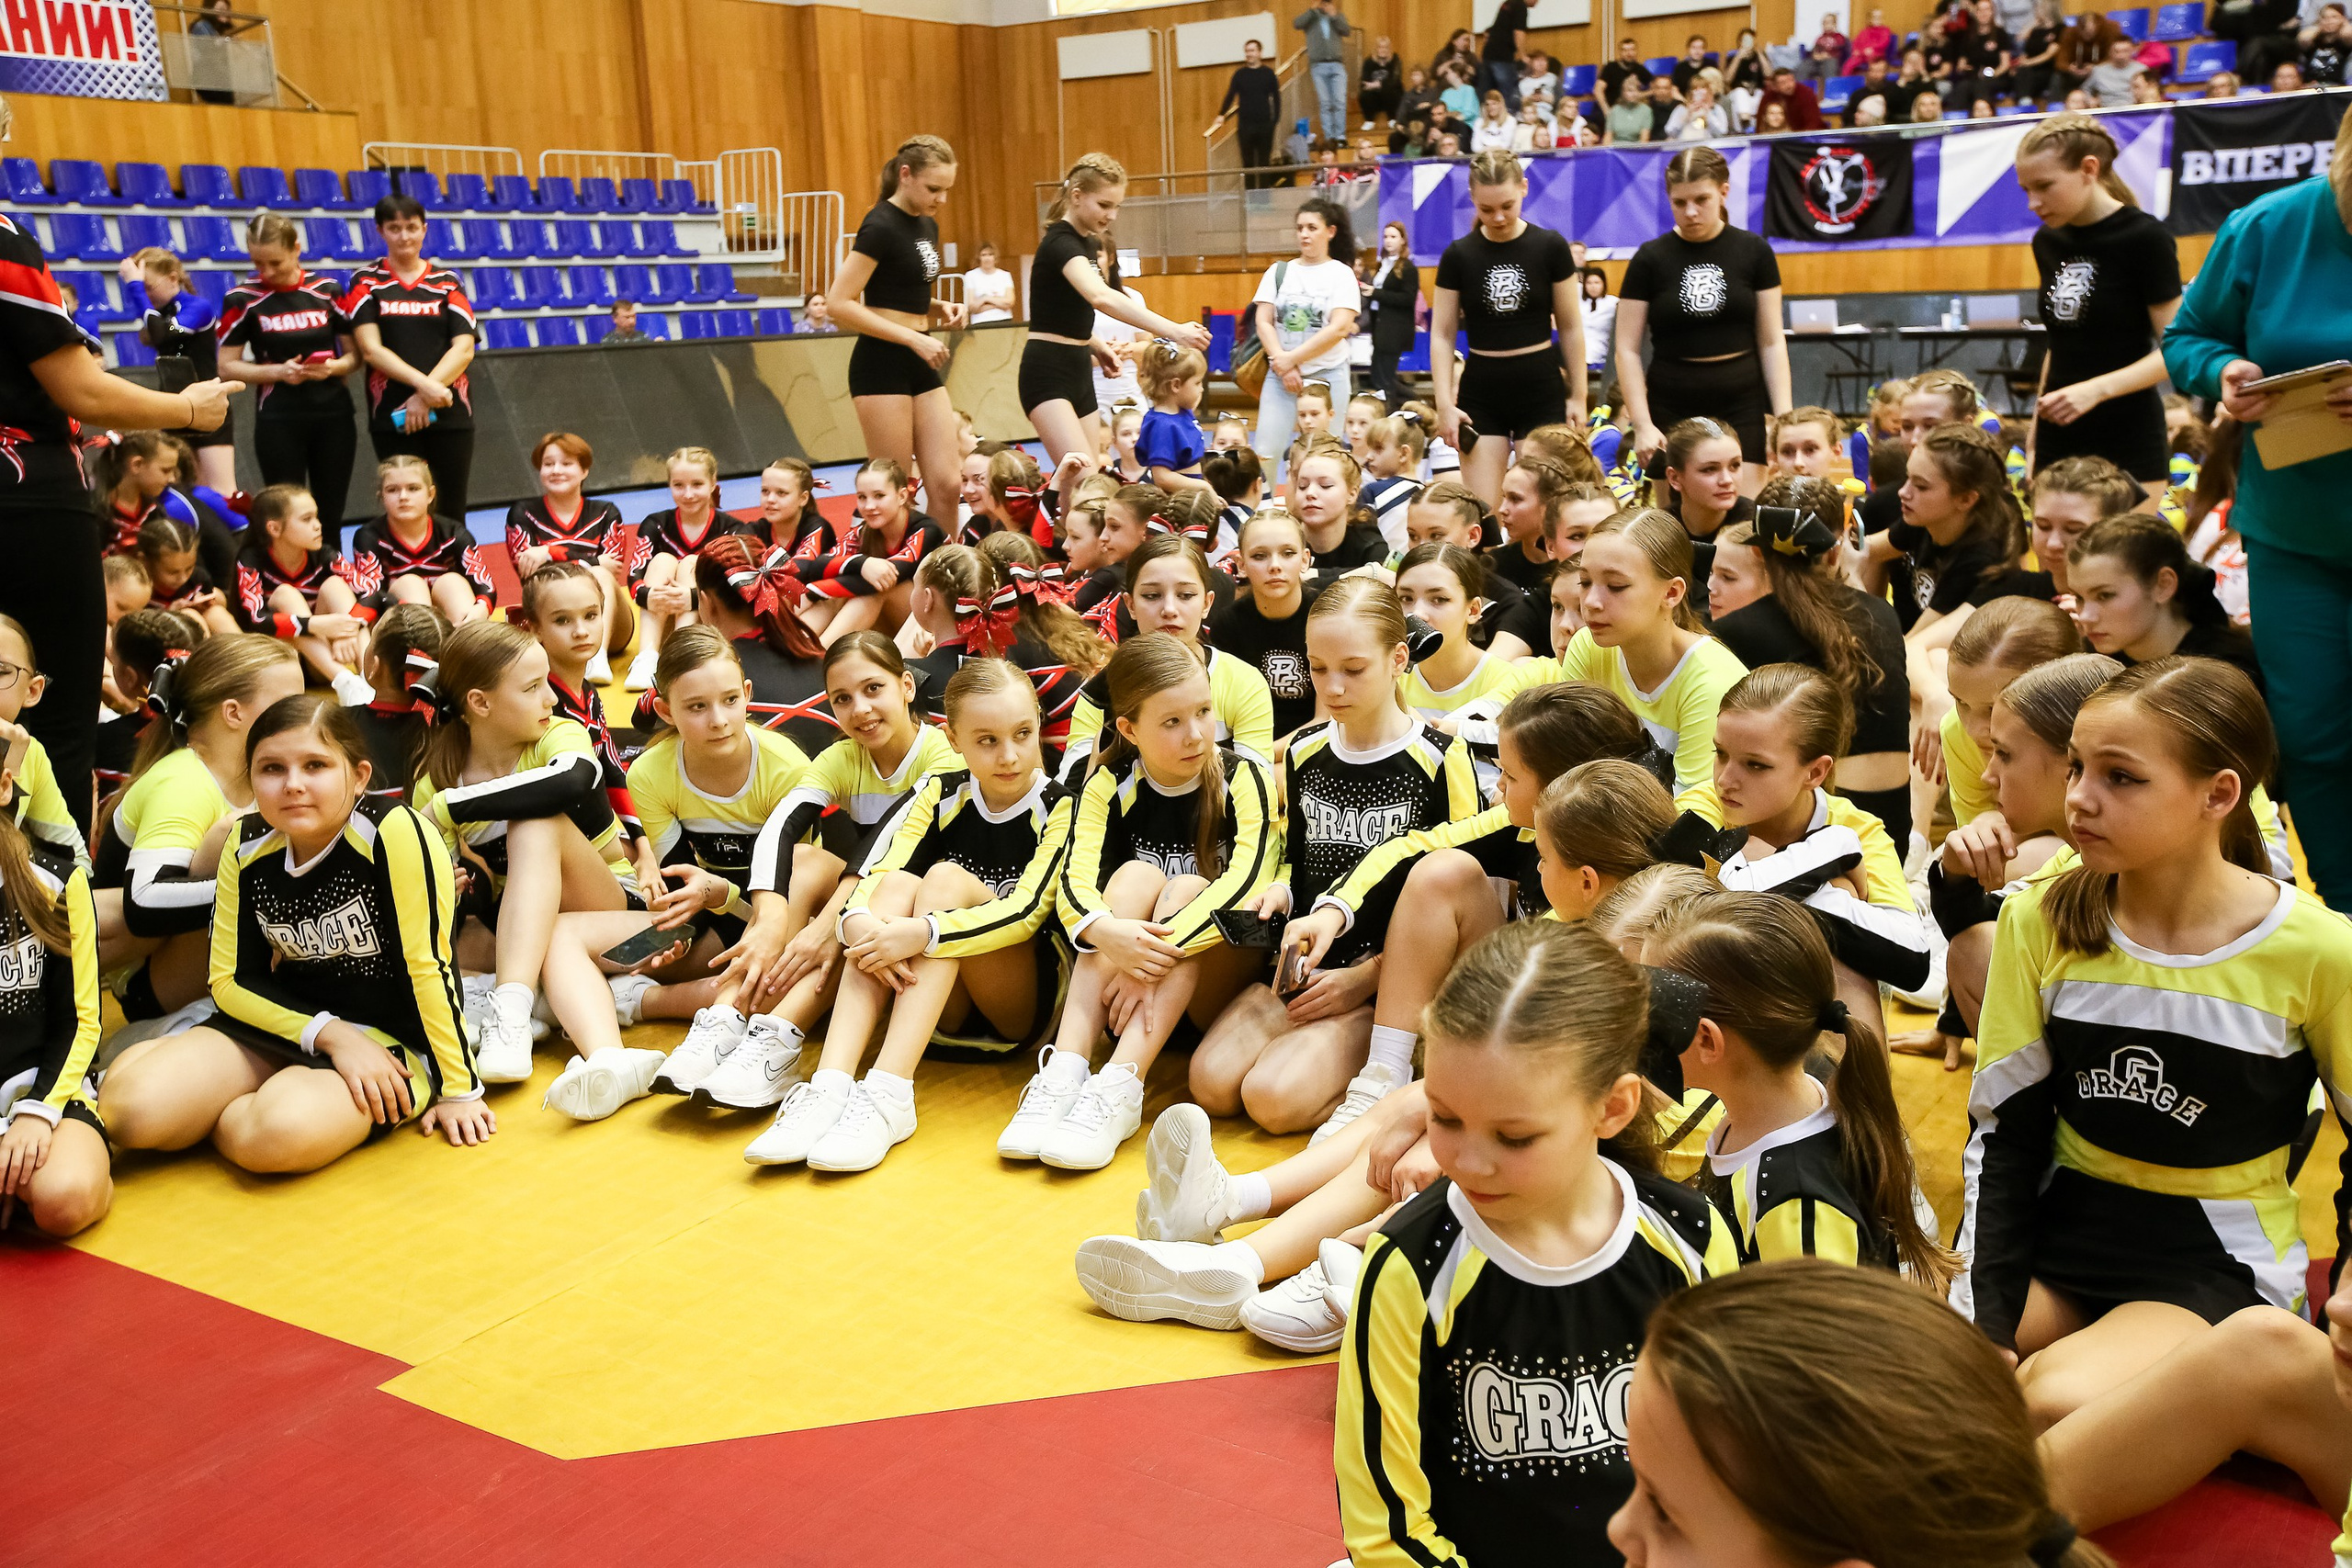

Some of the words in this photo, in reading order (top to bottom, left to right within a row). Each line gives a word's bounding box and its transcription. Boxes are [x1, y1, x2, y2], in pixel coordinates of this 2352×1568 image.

[2179, 140, 2335, 185] ВПЕРЕ
[259, 310, 329, 332] BEAUTY
[379, 299, 443, 315] BEAUTY
[2075, 1068, 2208, 1127] GRACE
[1464, 1361, 1638, 1462] GRAC
